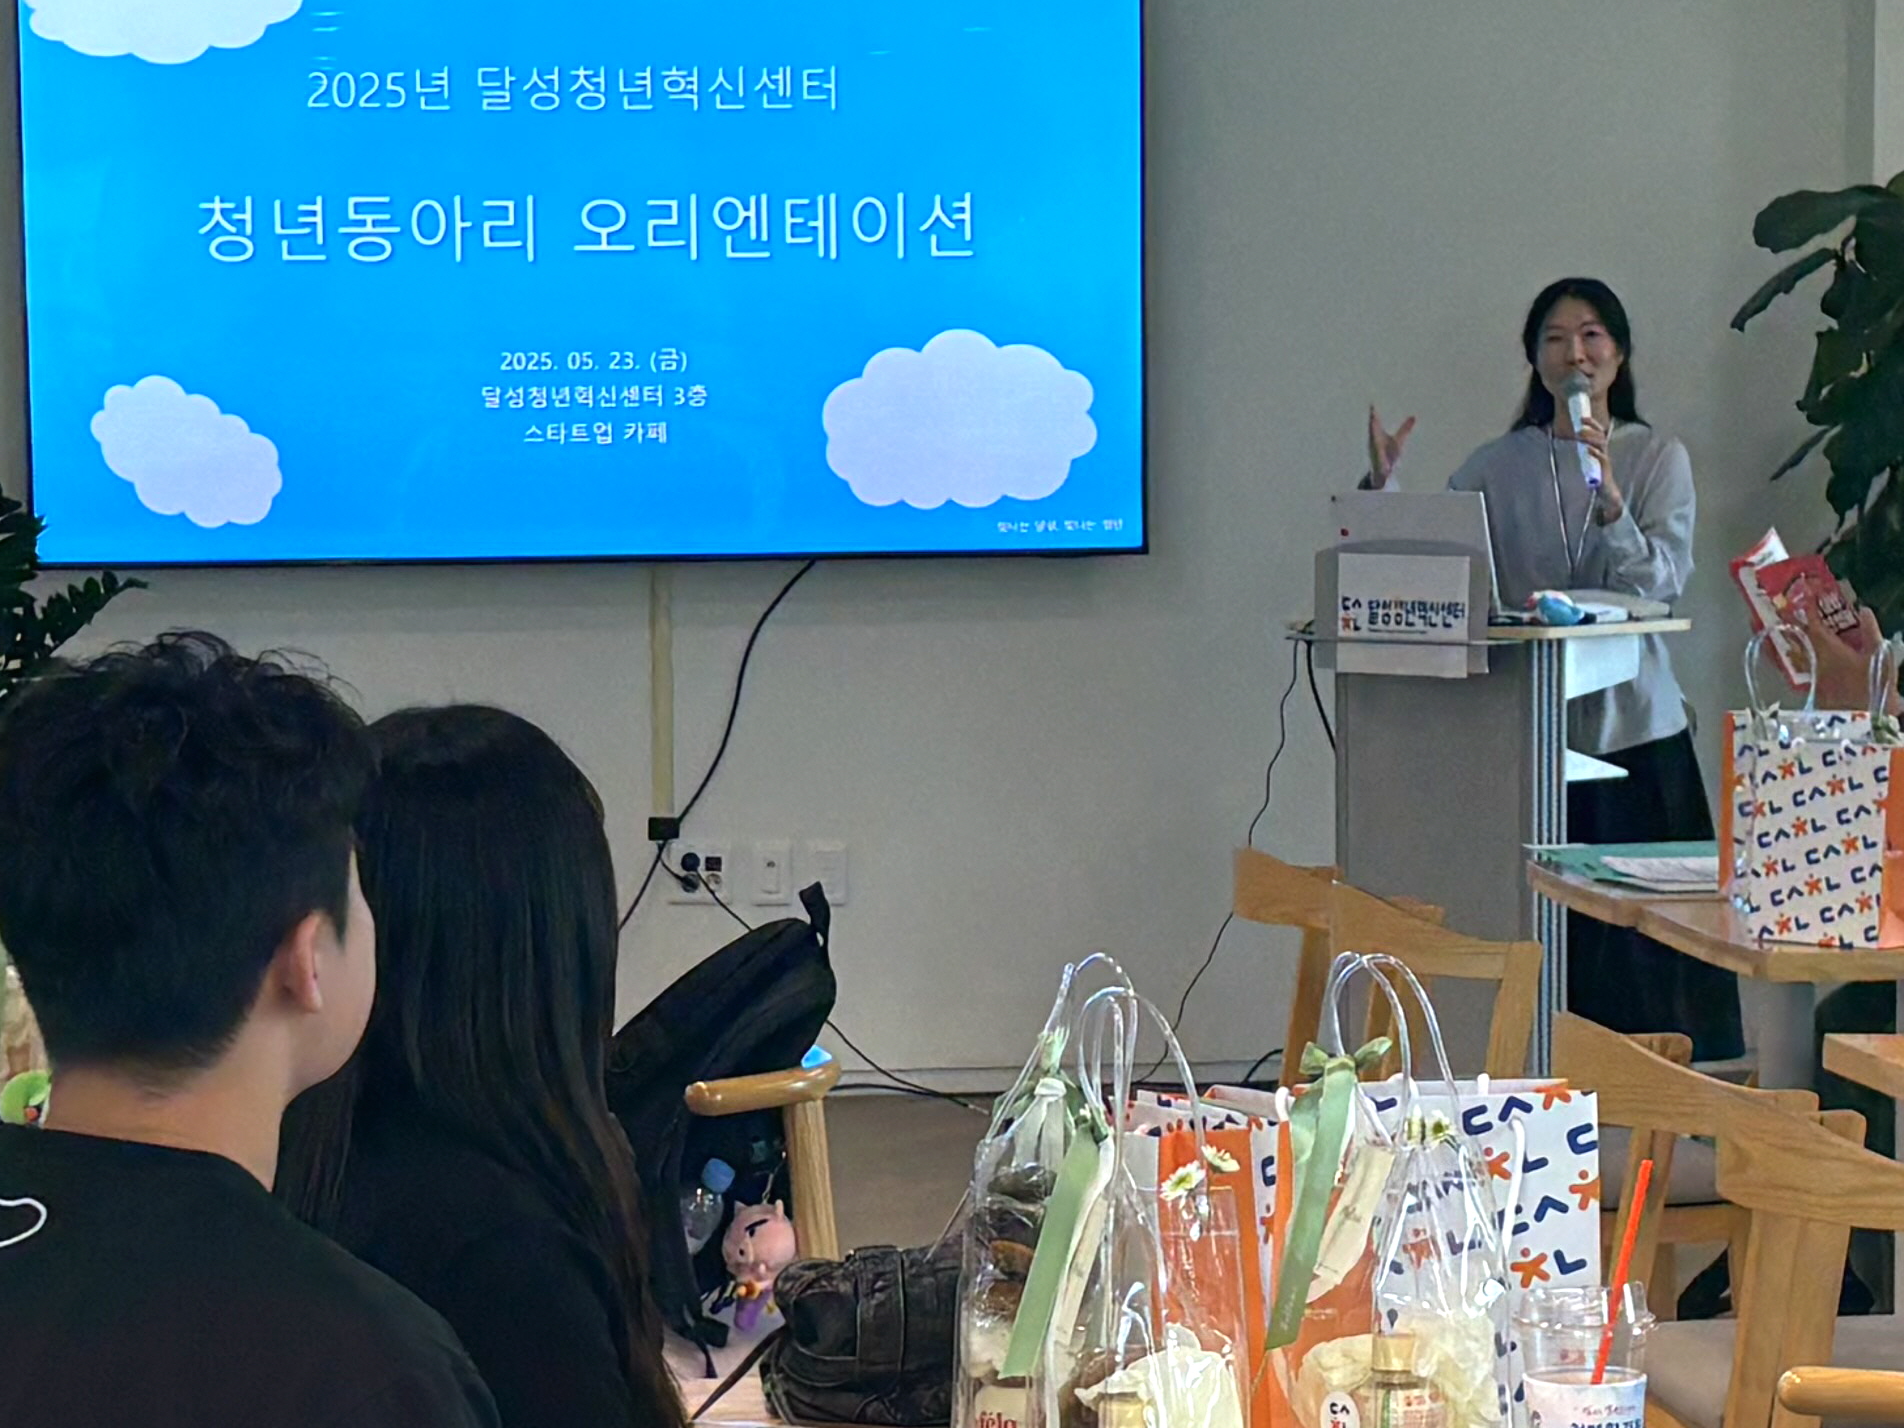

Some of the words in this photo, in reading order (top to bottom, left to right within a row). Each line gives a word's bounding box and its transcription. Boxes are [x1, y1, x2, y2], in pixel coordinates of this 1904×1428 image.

[306, 66, 452, 112] 2025년
[476, 64, 839, 112] 달성청년혁신센터
[196, 193, 536, 263] 청년동아리
[572, 190, 977, 262] 오리엔테이션
[499, 351, 559, 371] 2025.
[566, 351, 599, 371] 05.
[608, 351, 641, 371] 23.
[649, 347, 688, 373] (금)
[481, 384, 664, 409] 달성청년혁신센터
[673, 383, 709, 408] 3층
[523, 421, 614, 445] 스타트업
[623, 420, 668, 444] 카페
